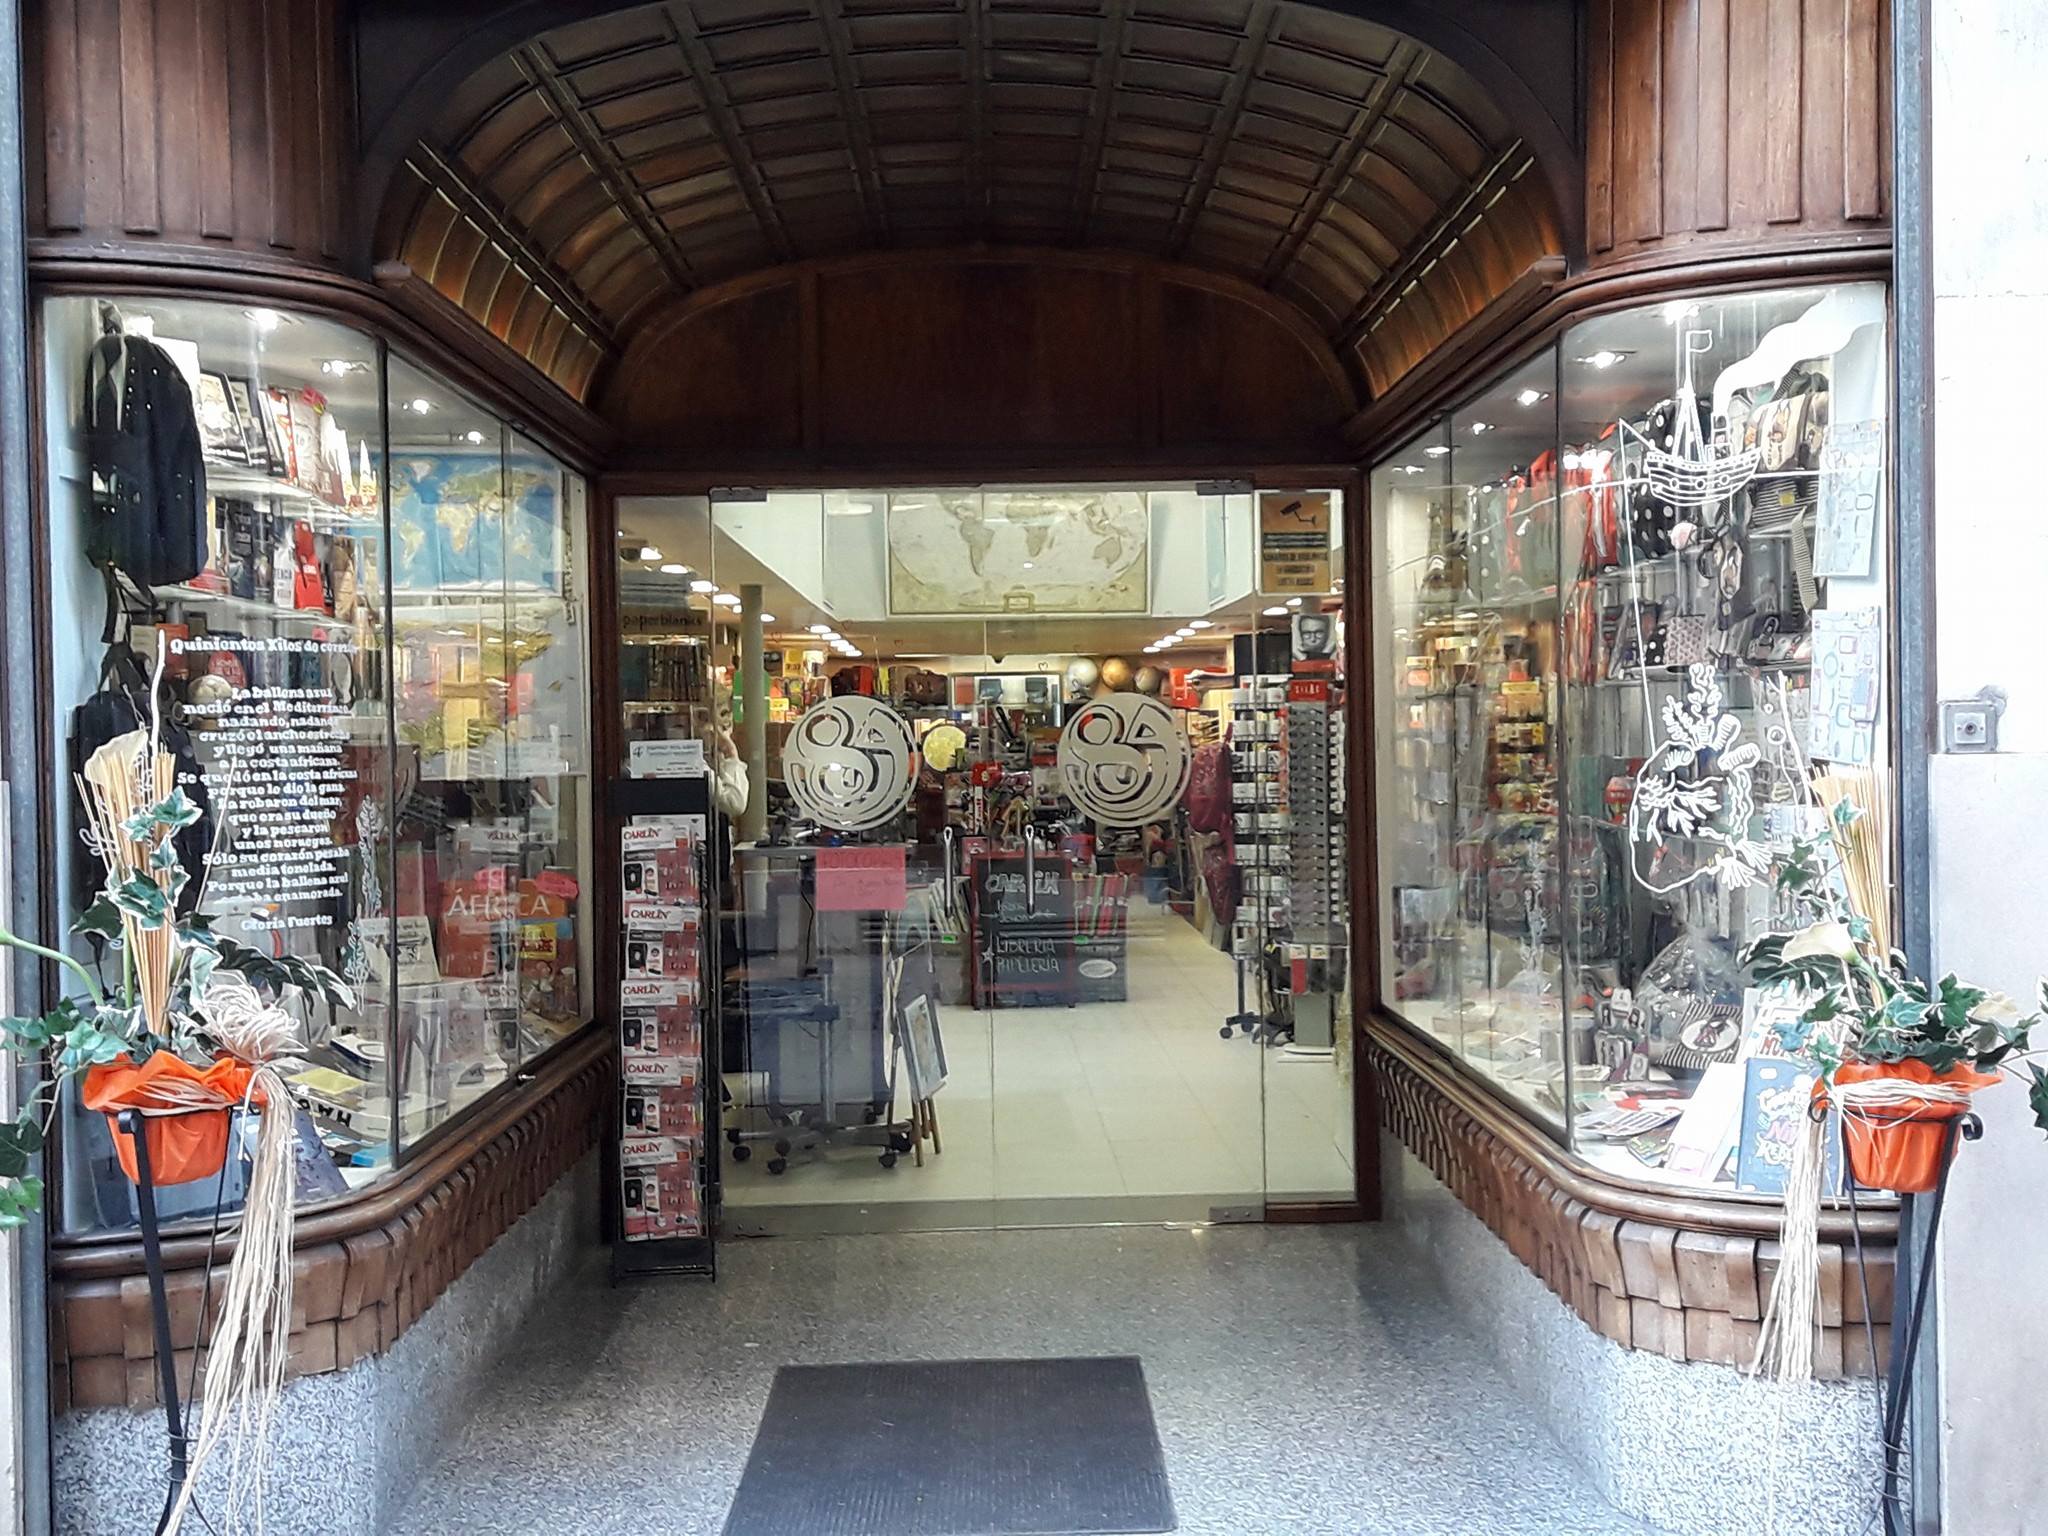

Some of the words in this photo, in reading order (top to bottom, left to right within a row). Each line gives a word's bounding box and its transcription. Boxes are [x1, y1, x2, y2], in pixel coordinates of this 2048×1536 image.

[171, 637, 265, 654] Quinientos
[232, 688, 249, 700] La
[252, 686, 305, 698] ballena
[306, 688, 333, 698] azul
[183, 700, 231, 714] nació
[234, 703, 255, 714] en
[255, 702, 269, 713] el
[218, 716, 289, 728] nadando,
[199, 730, 245, 741] cruzó
[247, 730, 264, 741] el
[265, 730, 306, 740] ancho
[213, 746, 226, 757] y
[227, 744, 265, 757] llegó
[270, 745, 297, 754] una
[297, 743, 343, 753] mañana
[219, 759, 230, 768] a
[250, 757, 288, 768] costa
[177, 772, 196, 784] Se
[200, 771, 251, 785] quedó
[252, 772, 271, 781] en
[273, 770, 287, 780] la
[289, 769, 321, 780] costa
[207, 786, 265, 799] porque
[306, 782, 318, 793] la
[240, 797, 297, 809] robaron
[299, 796, 319, 807] del
[228, 814, 257, 825] que
[259, 812, 283, 822] era
[286, 811, 302, 821] su
[303, 809, 336, 820] dueño
[242, 827, 251, 839] y
[254, 825, 269, 835] la
[271, 823, 329, 837] pescaron
[234, 838, 272, 849] unos
[202, 851, 237, 865] Sólo
[240, 853, 258, 863] su
[260, 848, 314, 863] corazón
[315, 848, 349, 861] pesaba
[231, 864, 280, 877] media
[207, 879, 264, 893] Porque
[266, 877, 280, 889] la
[281, 875, 328, 889] ballena
[329, 872, 349, 884] azul
[241, 916, 285, 931] Gloria
[288, 914, 333, 928] Fuertes
